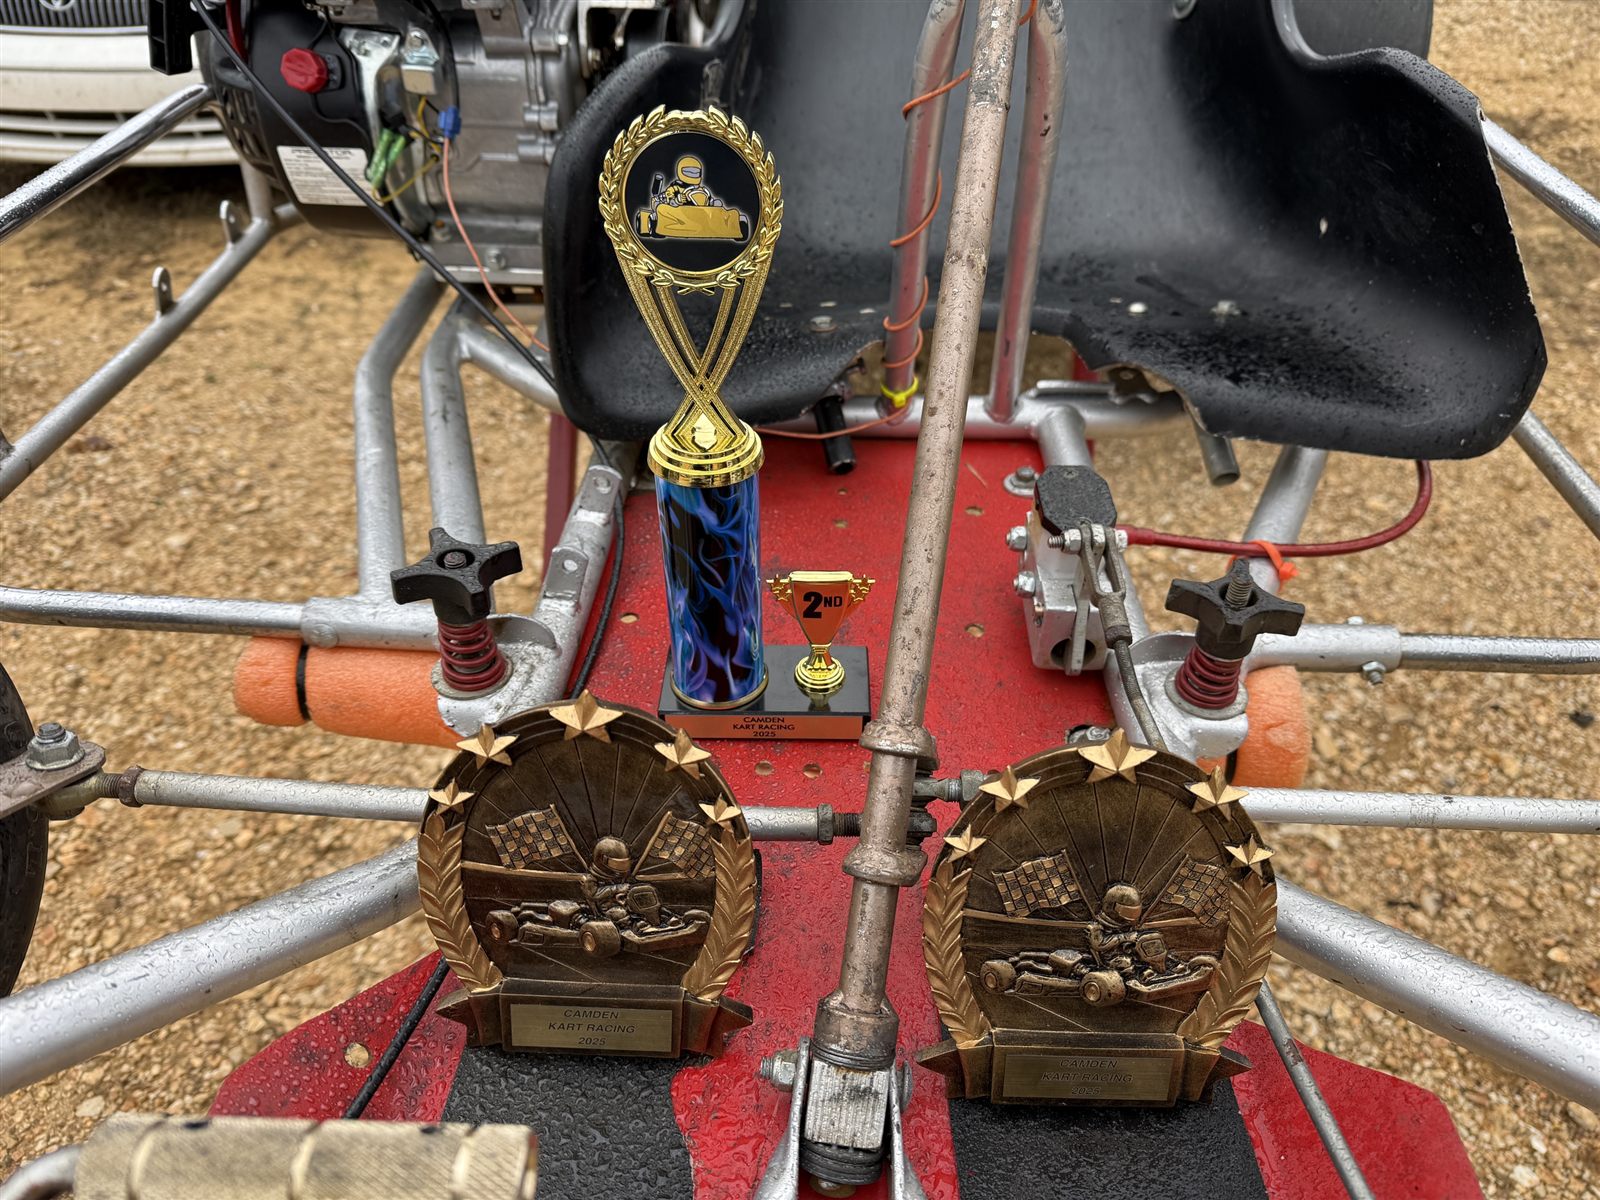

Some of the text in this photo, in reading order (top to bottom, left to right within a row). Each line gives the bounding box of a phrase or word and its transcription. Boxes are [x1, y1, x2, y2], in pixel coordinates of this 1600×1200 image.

[803, 591, 843, 619] 2ND
[563, 1009, 619, 1019] CAMDEN
[548, 1022, 635, 1034] KART RACING
[578, 1037, 606, 1046] 2025
[1060, 1059, 1118, 1069] CAMDEN
[1041, 1072, 1133, 1083] KART RACING
[1071, 1087, 1100, 1095] 2025
